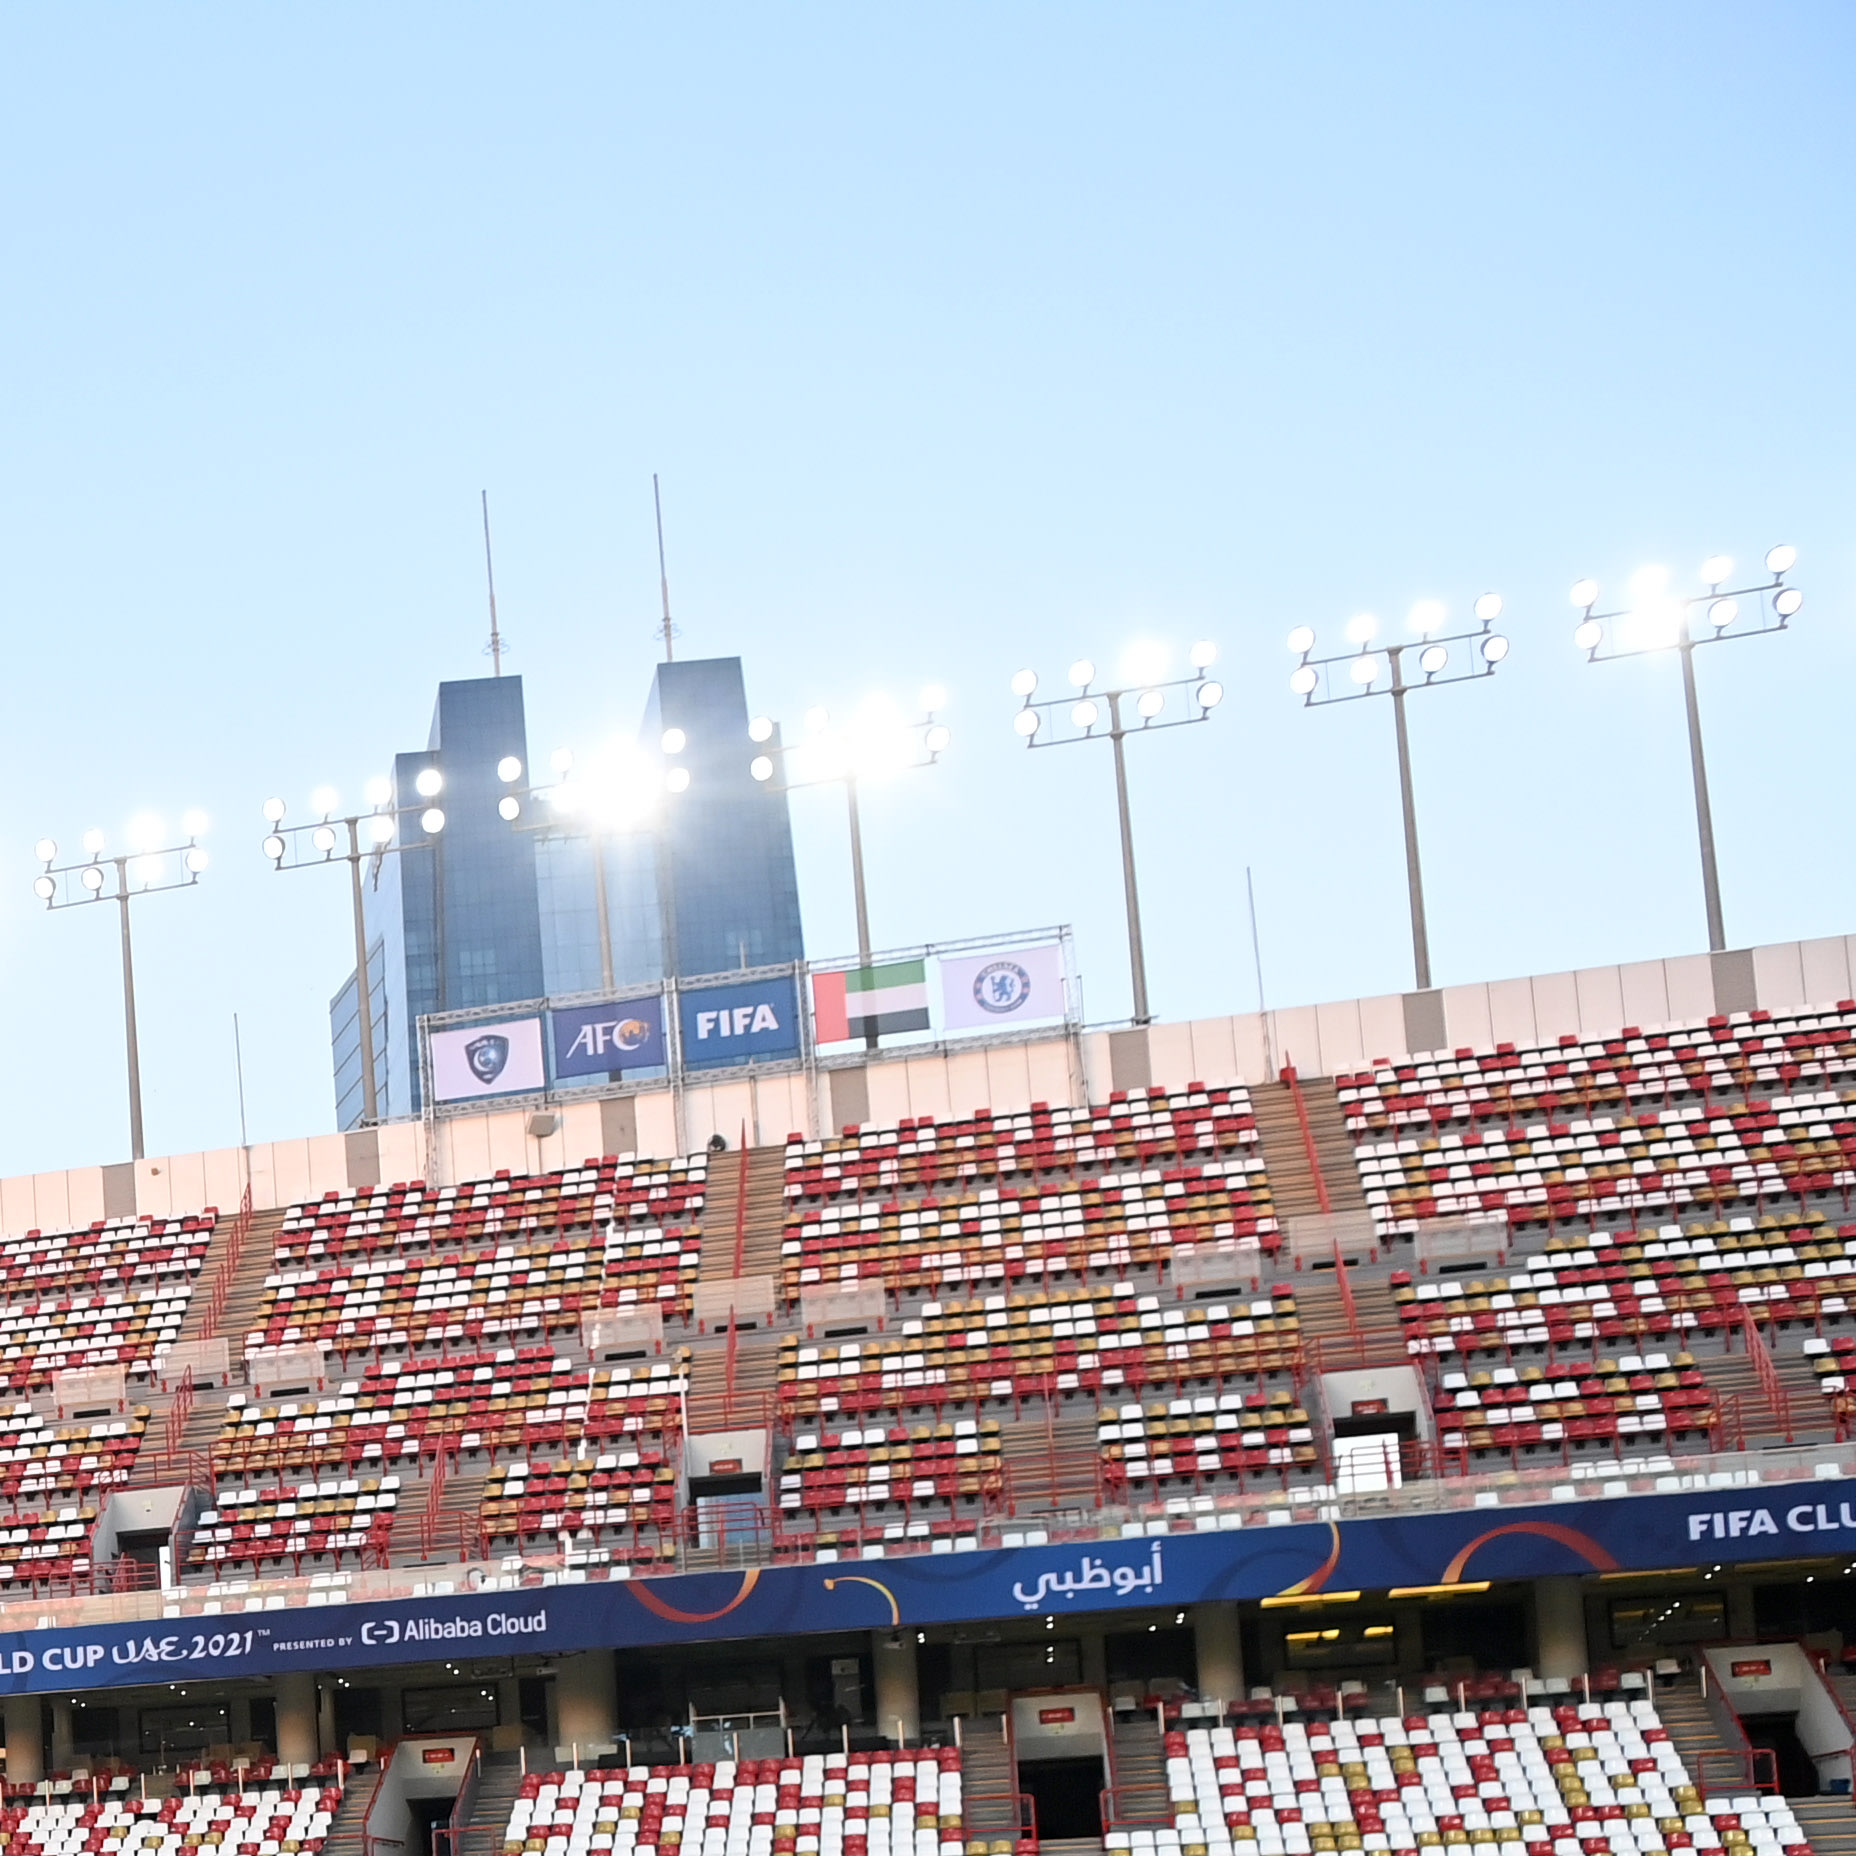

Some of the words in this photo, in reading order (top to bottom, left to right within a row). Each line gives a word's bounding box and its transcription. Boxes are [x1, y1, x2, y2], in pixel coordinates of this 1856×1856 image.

[566, 1018, 640, 1058] AFC
[696, 1004, 779, 1039] FIFA
[1688, 1508, 1779, 1541] FIFA
[1786, 1502, 1856, 1532] CLU
[1012, 1541, 1164, 1609] أبوظبي
[42, 1645, 104, 1669] CUP
[273, 1639, 335, 1651] PRESENTED
[339, 1637, 353, 1647] BY
[403, 1616, 483, 1642] Alibaba
[486, 1610, 547, 1634] Cloud
